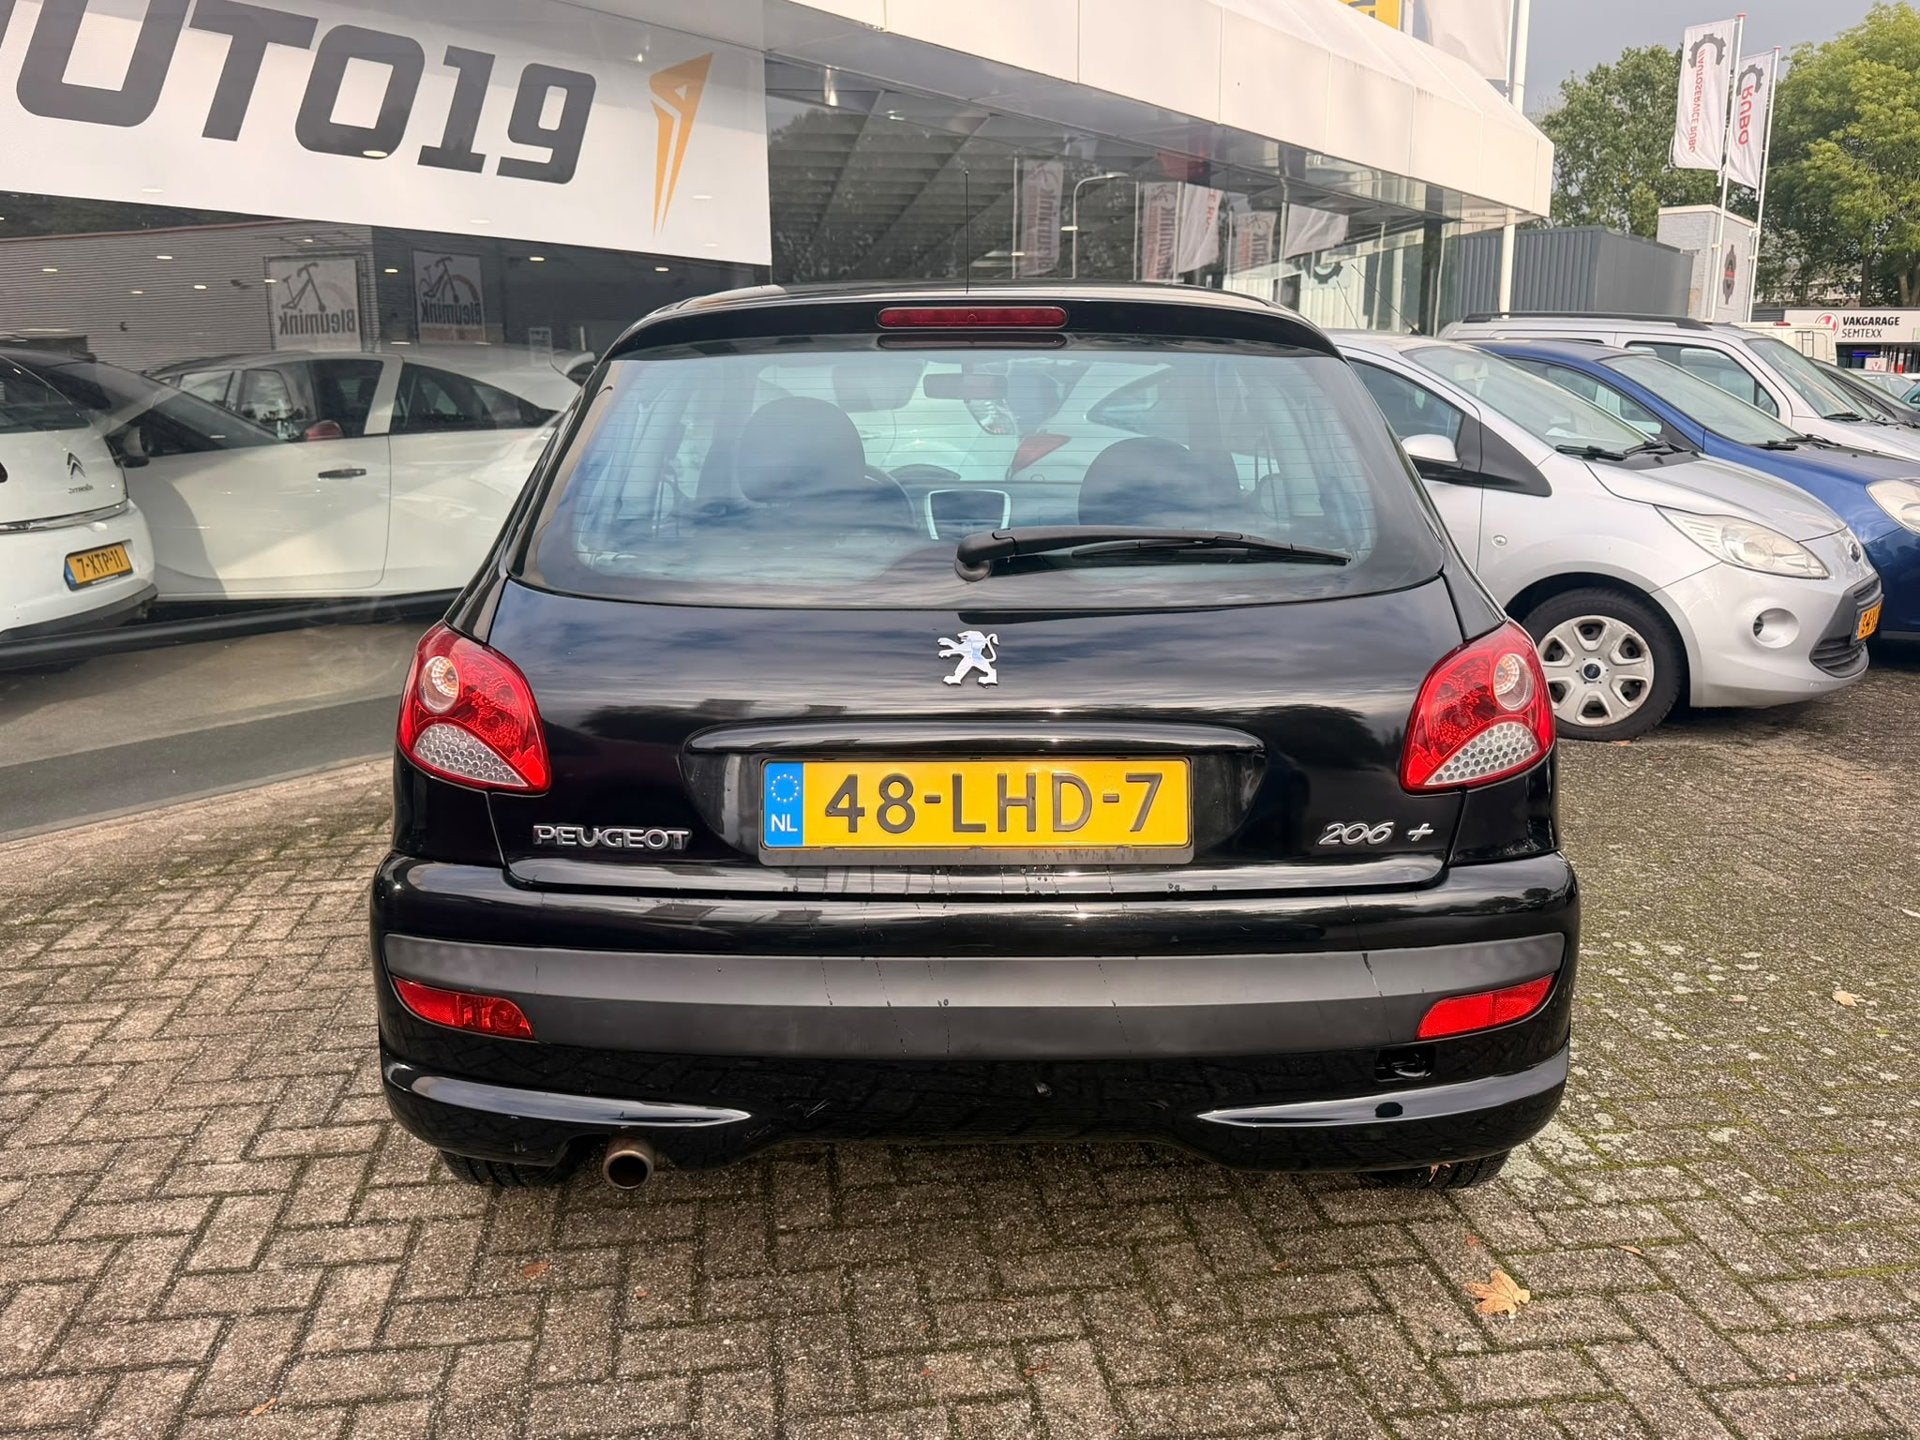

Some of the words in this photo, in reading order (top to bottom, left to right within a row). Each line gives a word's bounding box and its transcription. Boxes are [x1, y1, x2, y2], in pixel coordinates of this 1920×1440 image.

[0, 0, 597, 185] UTO19
[1841, 328, 1883, 338] SEMTEXX
[1843, 316, 1900, 326] VAKGARAGE
[76, 548, 124, 578] 7-XTP-11
[824, 772, 1163, 834] 48-LHD-7
[770, 813, 798, 833] NL
[1317, 820, 1397, 846] 206
[532, 824, 691, 851] PEUGEOT
